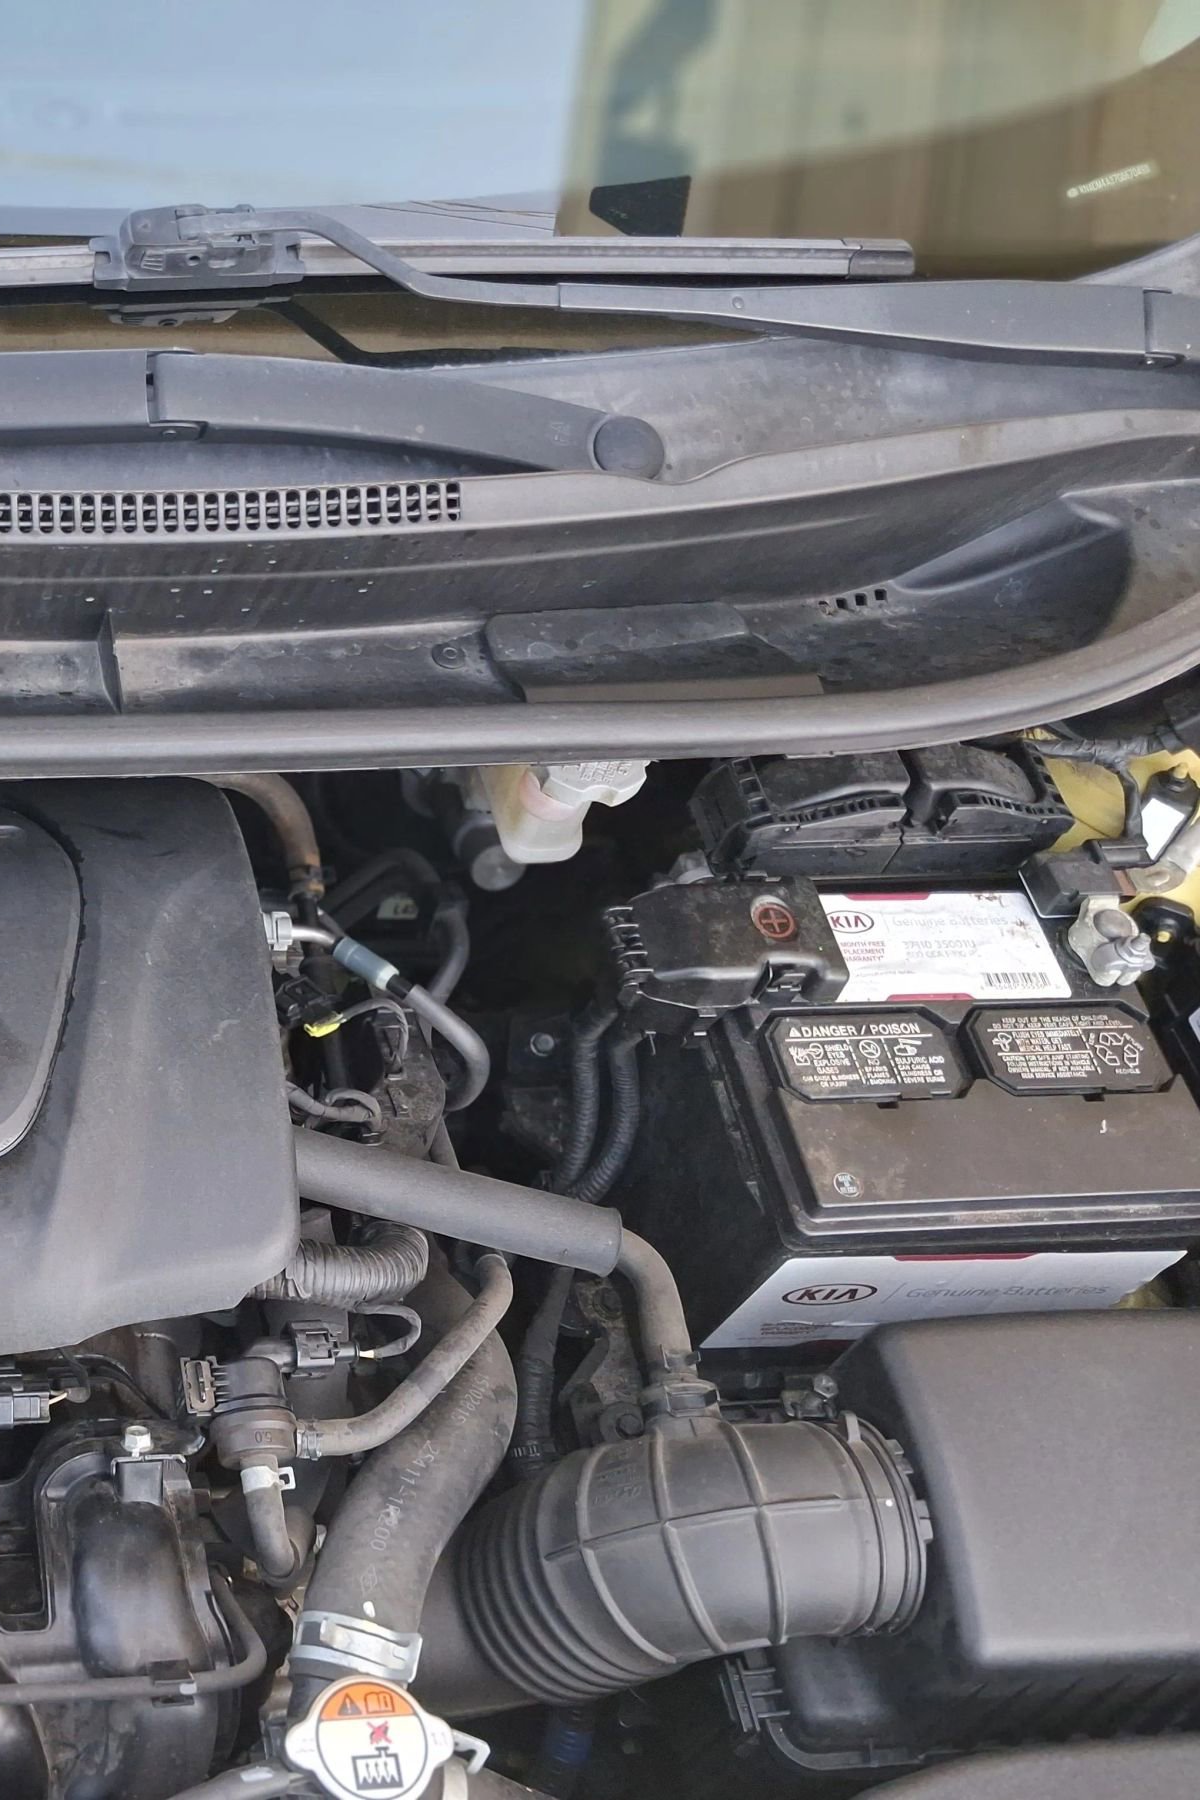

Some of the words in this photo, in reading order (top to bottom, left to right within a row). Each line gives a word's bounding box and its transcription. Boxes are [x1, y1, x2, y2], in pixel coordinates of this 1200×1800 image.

[829, 915, 867, 930] KIA
[801, 1025, 857, 1038] DANGER
[869, 1023, 921, 1035] POISON
[824, 1043, 850, 1052] SHIELD
[1018, 1044, 1043, 1052] MEDICAL
[1058, 1043, 1072, 1051] FAST
[827, 1051, 846, 1059] EYES
[813, 1058, 851, 1067] EXPLOSIVE
[867, 1058, 880, 1066] NO
[894, 1056, 928, 1065] SULFURIC
[928, 1055, 945, 1064] ACID
[816, 1066, 840, 1074] GASES
[864, 1065, 888, 1073] SPARKS
[900, 1069, 933, 1077] BLINDNESS
[867, 1071, 890, 1079] FLAMES
[903, 1076, 925, 1084] SEVERE
[800, 1287, 859, 1301] KIA
[905, 1286, 999, 1298] Genuine
[1002, 1284, 1110, 1297] Batteries
